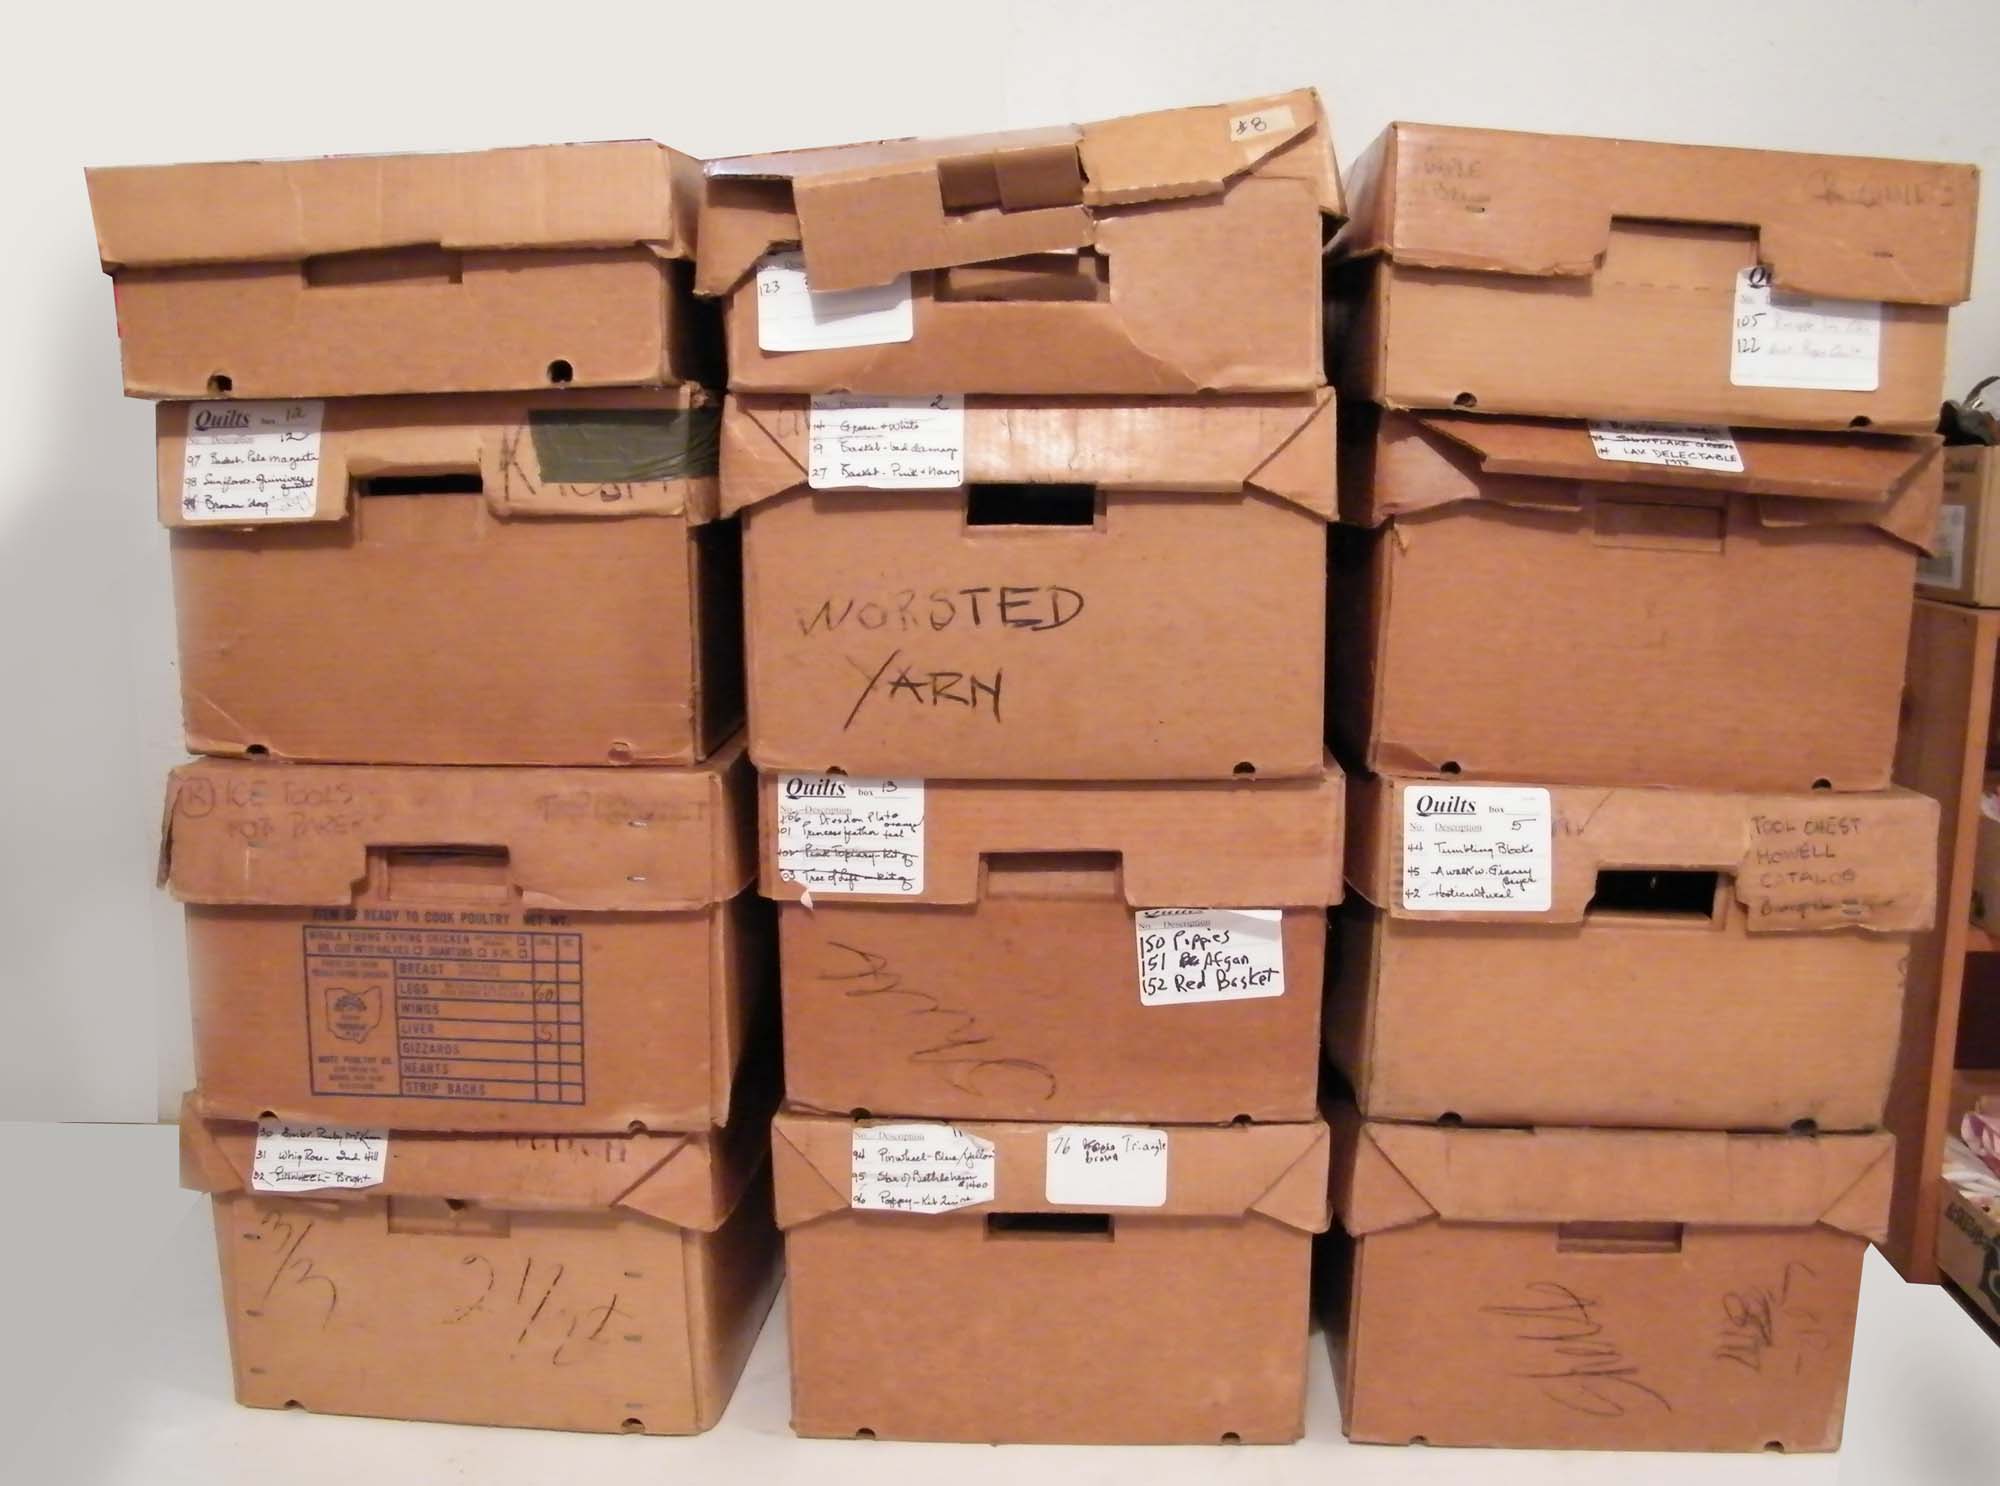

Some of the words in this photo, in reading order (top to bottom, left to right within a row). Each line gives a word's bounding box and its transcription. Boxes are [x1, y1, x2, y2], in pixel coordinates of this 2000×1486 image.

[759, 280, 781, 297] 123
[1737, 312, 1767, 328] 105
[1737, 337, 1760, 353] 122
[930, 394, 950, 410] 2
[194, 407, 250, 431] Quilts
[280, 432, 311, 443] 12
[1652, 449, 1738, 463] DELECTABLE
[812, 467, 828, 480] 27
[796, 584, 1085, 637] WORSTED
[843, 648, 1003, 732] YARN
[786, 777, 847, 800] Quilts
[858, 788, 873, 796] box
[1416, 794, 1477, 817] Quilts
[1489, 806, 1504, 814] box
[1434, 823, 1483, 833] Description
[1511, 818, 1537, 831] 5
[1751, 816, 1796, 835] TOOL
[1804, 816, 1861, 836] CHEST
[1434, 842, 1494, 859] Tumbling
[364, 909, 399, 922] READY
[406, 910, 419, 922] TO
[425, 911, 453, 923] COOK
[461, 911, 510, 925] POULTRY
[400, 963, 443, 975] BREAST
[1203, 951, 1249, 973] Afgan
[1174, 970, 1206, 992] Red
[1216, 967, 1280, 992] Basket
[400, 984, 429, 994] LEGS
[401, 1004, 440, 1015] WINGS
[401, 1023, 434, 1034] LIVER
[402, 1042, 461, 1055] GIZZARDS
[404, 1062, 449, 1074] HEARTS
[405, 1080, 439, 1093] STRIP
[448, 1082, 486, 1096] BACKS
